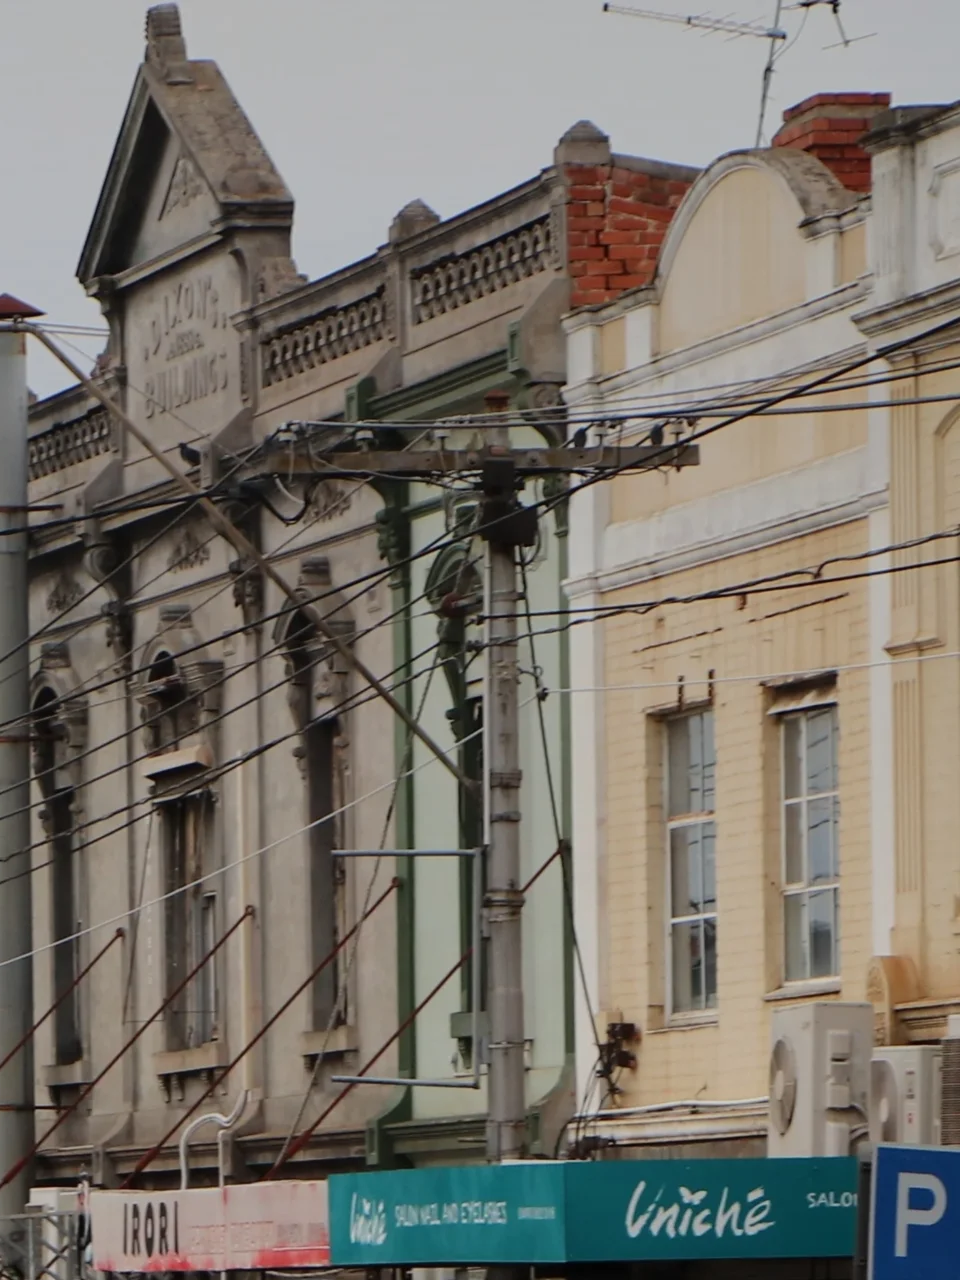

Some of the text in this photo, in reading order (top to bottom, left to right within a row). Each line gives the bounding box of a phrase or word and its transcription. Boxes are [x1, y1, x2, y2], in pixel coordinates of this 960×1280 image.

[806, 1191, 858, 1208] SALO
[894, 1171, 948, 1258] P
[123, 1200, 180, 1259] IRORI
